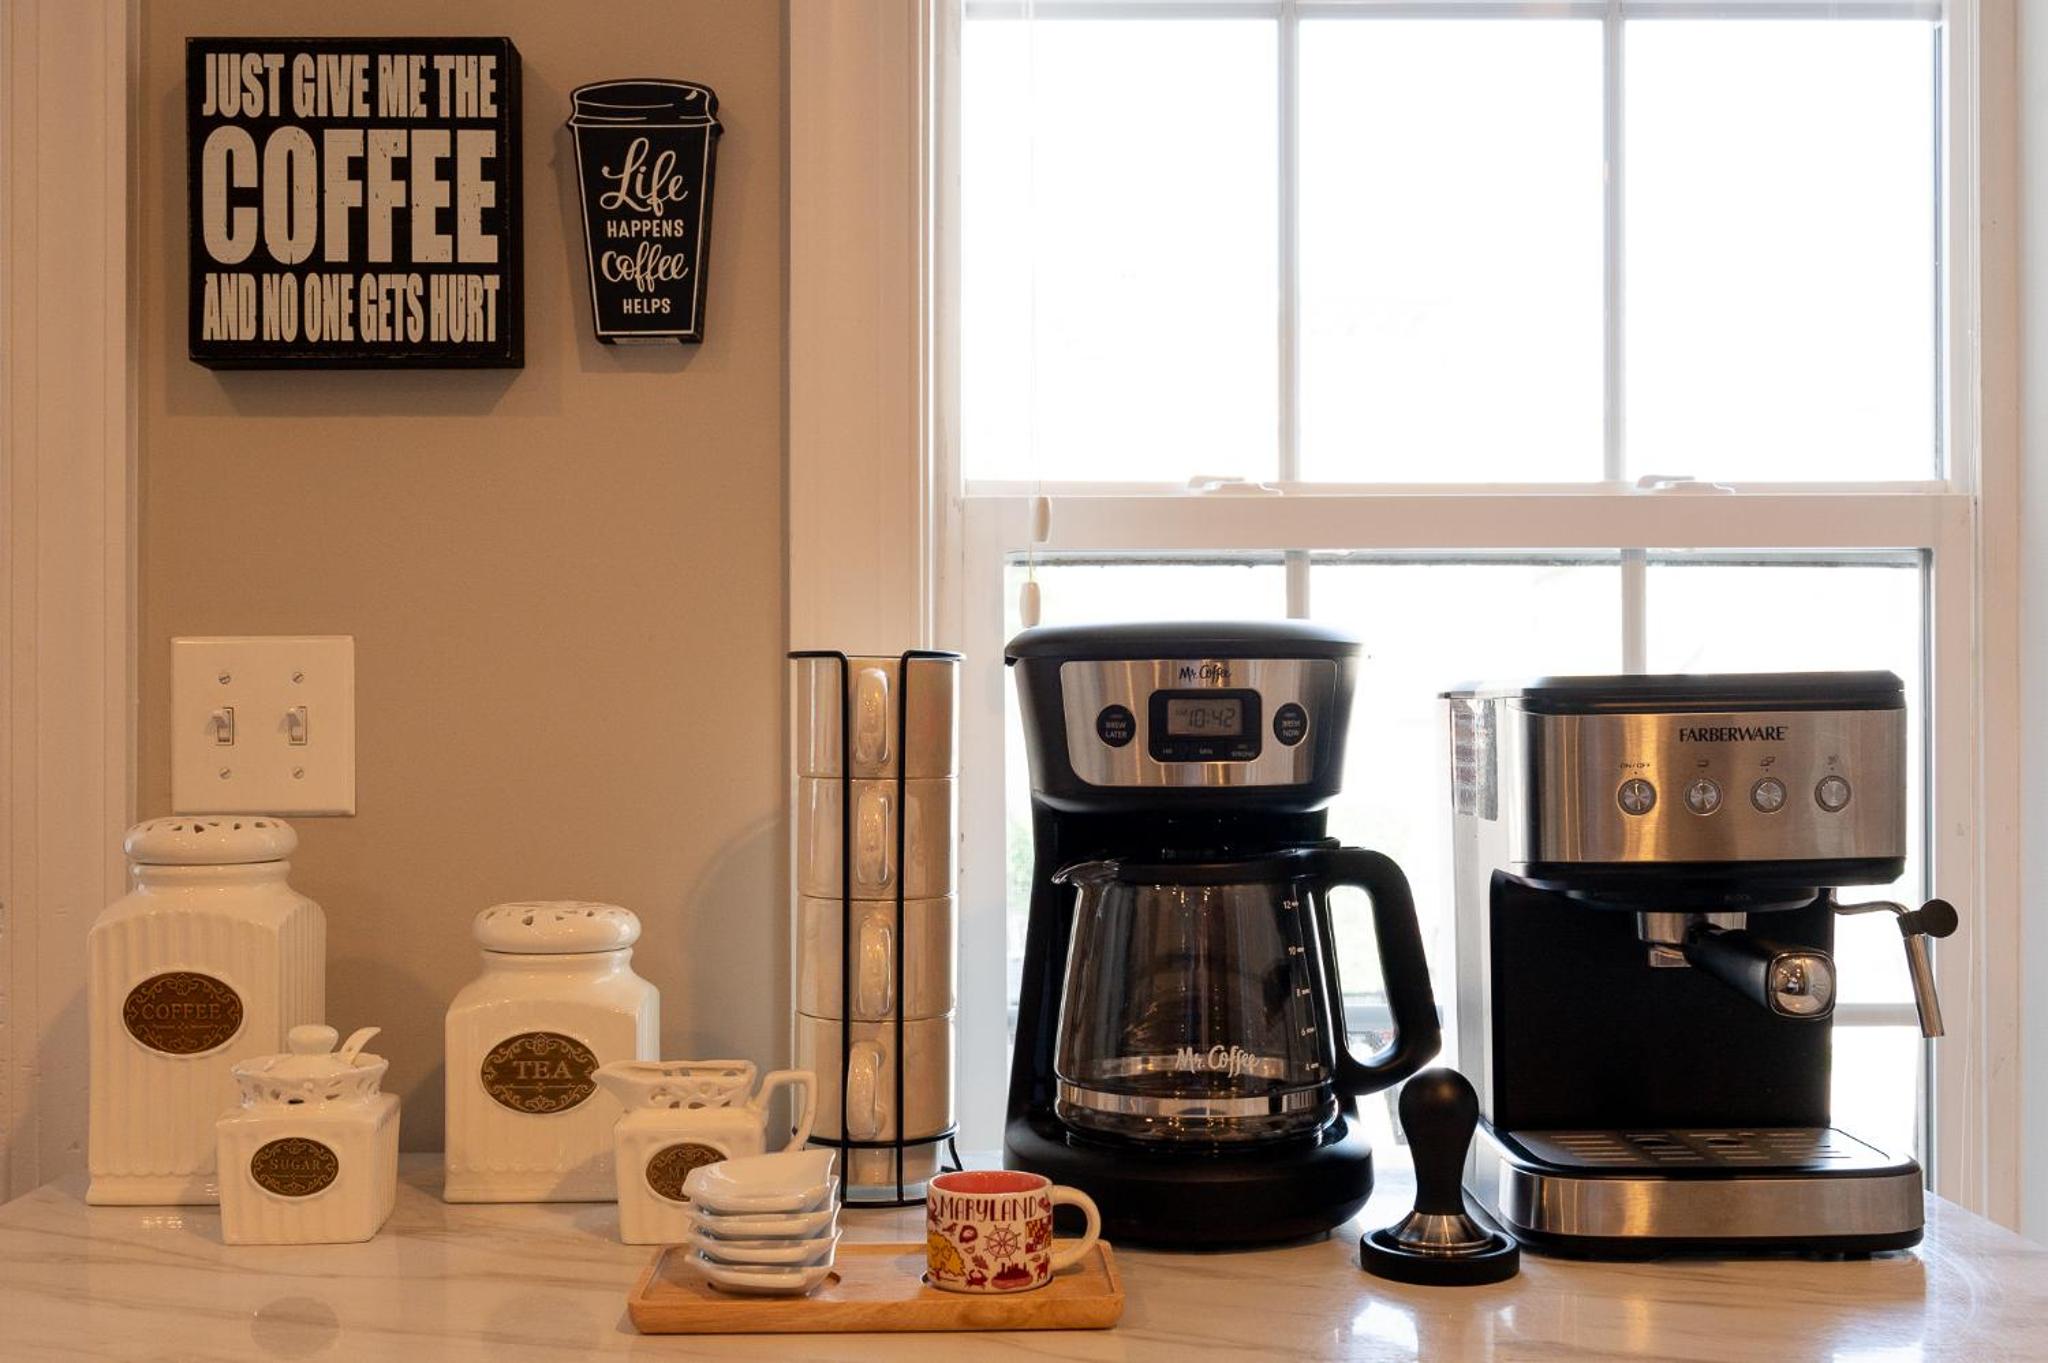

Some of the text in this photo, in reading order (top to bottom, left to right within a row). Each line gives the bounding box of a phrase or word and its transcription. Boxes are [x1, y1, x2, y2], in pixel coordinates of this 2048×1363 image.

[202, 53, 498, 118] JUST GIVE ME THE
[600, 137, 689, 217] Life
[202, 125, 499, 265] COFFEE
[606, 219, 685, 238] HAPPENS
[601, 241, 689, 293] Coffee
[202, 272, 501, 343] AND NO ONE GETS HURT
[623, 299, 672, 315] HELPS
[1189, 707, 1236, 728] 10:42
[1679, 726, 1787, 742] FARBERWARE
[141, 1002, 221, 1020] COFFEE
[512, 1059, 573, 1080] TEA
[1175, 1044, 1259, 1078] Mr. Coffee
[269, 1158, 321, 1171] SUGAR
[940, 1196, 1037, 1221] MARYLAND
